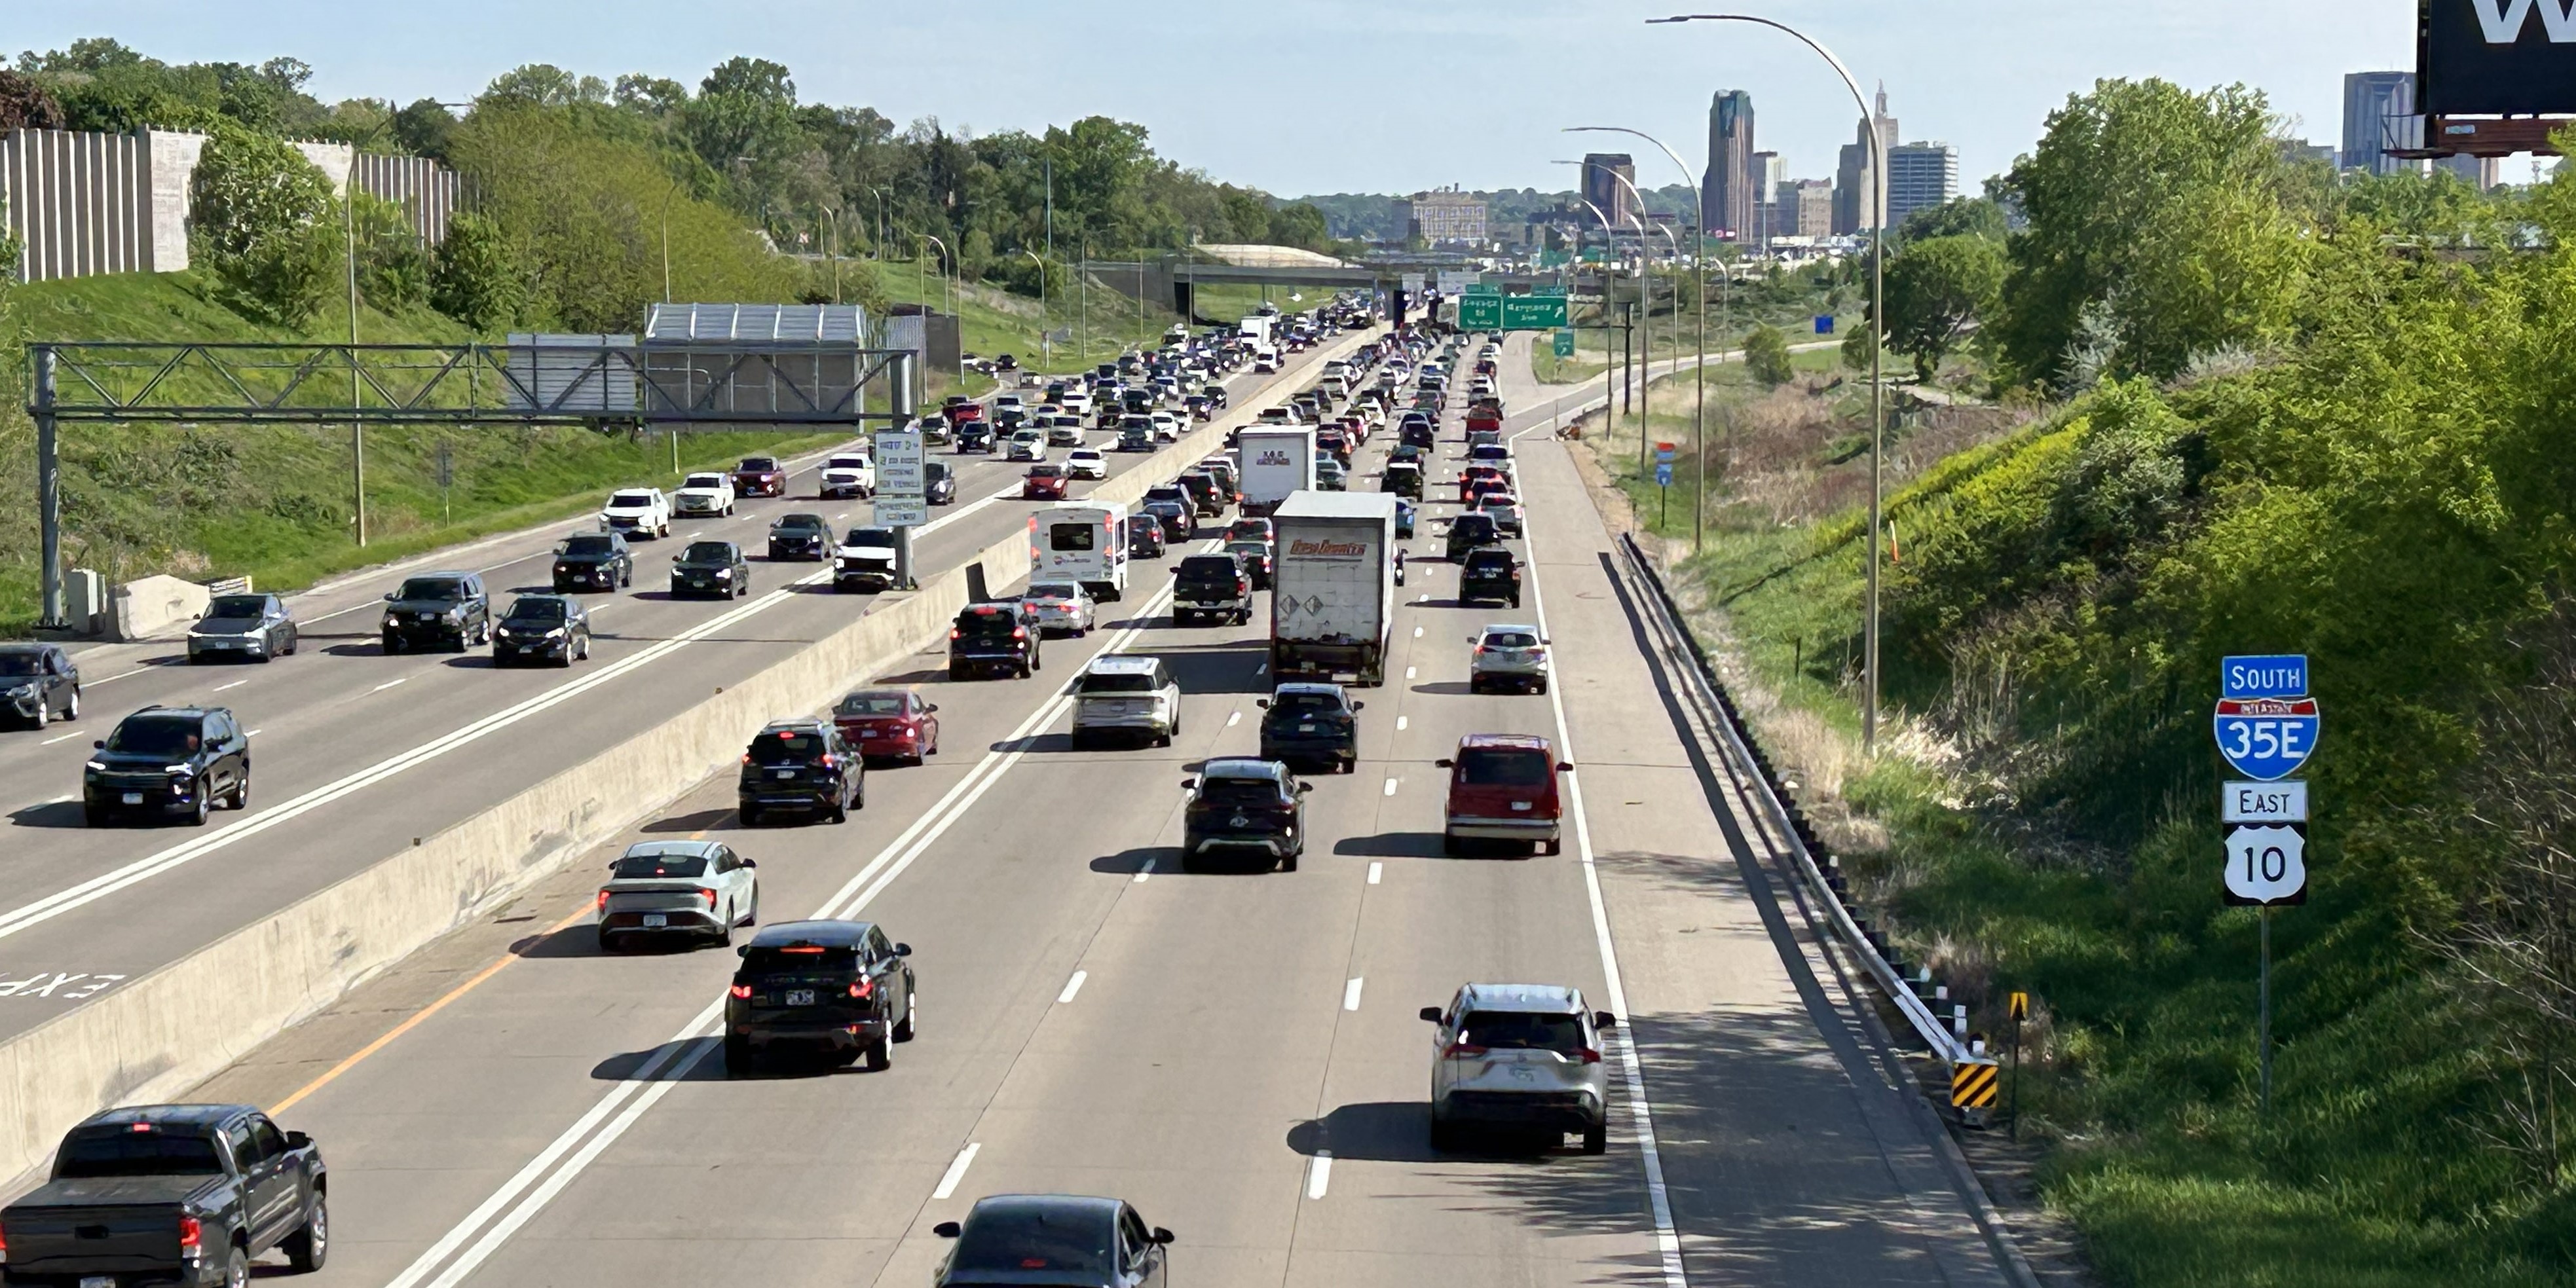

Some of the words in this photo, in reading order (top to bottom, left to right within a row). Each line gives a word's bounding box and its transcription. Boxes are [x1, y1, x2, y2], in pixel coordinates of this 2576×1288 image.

[2230, 665, 2301, 691] SOUTH
[2226, 721, 2305, 759] 35E
[2239, 789, 2291, 814] EAST
[2243, 846, 2286, 883] 10
[0, 972, 127, 999] EXP
